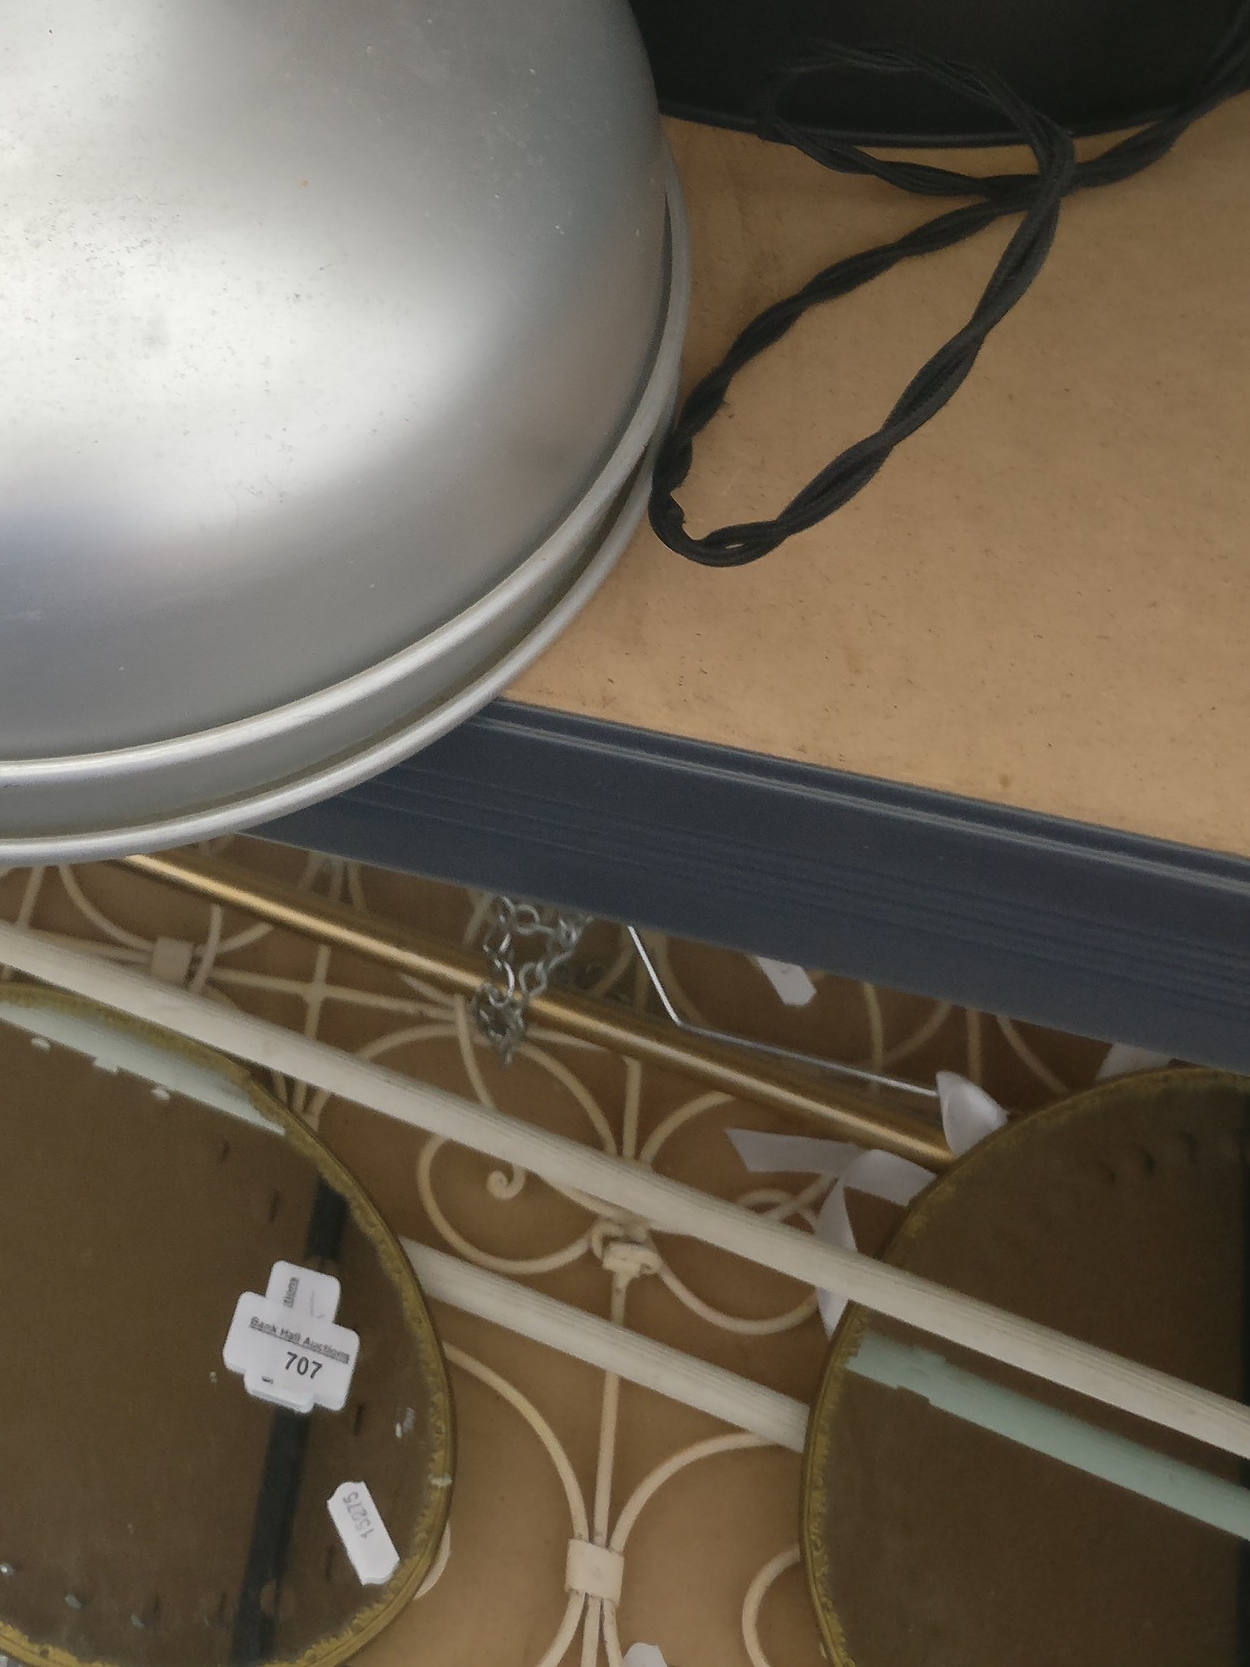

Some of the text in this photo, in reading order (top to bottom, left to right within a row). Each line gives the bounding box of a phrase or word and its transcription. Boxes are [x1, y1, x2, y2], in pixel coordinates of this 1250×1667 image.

[250, 1316, 350, 1363] Bank Hall Auctions
[285, 1351, 323, 1379] 707
